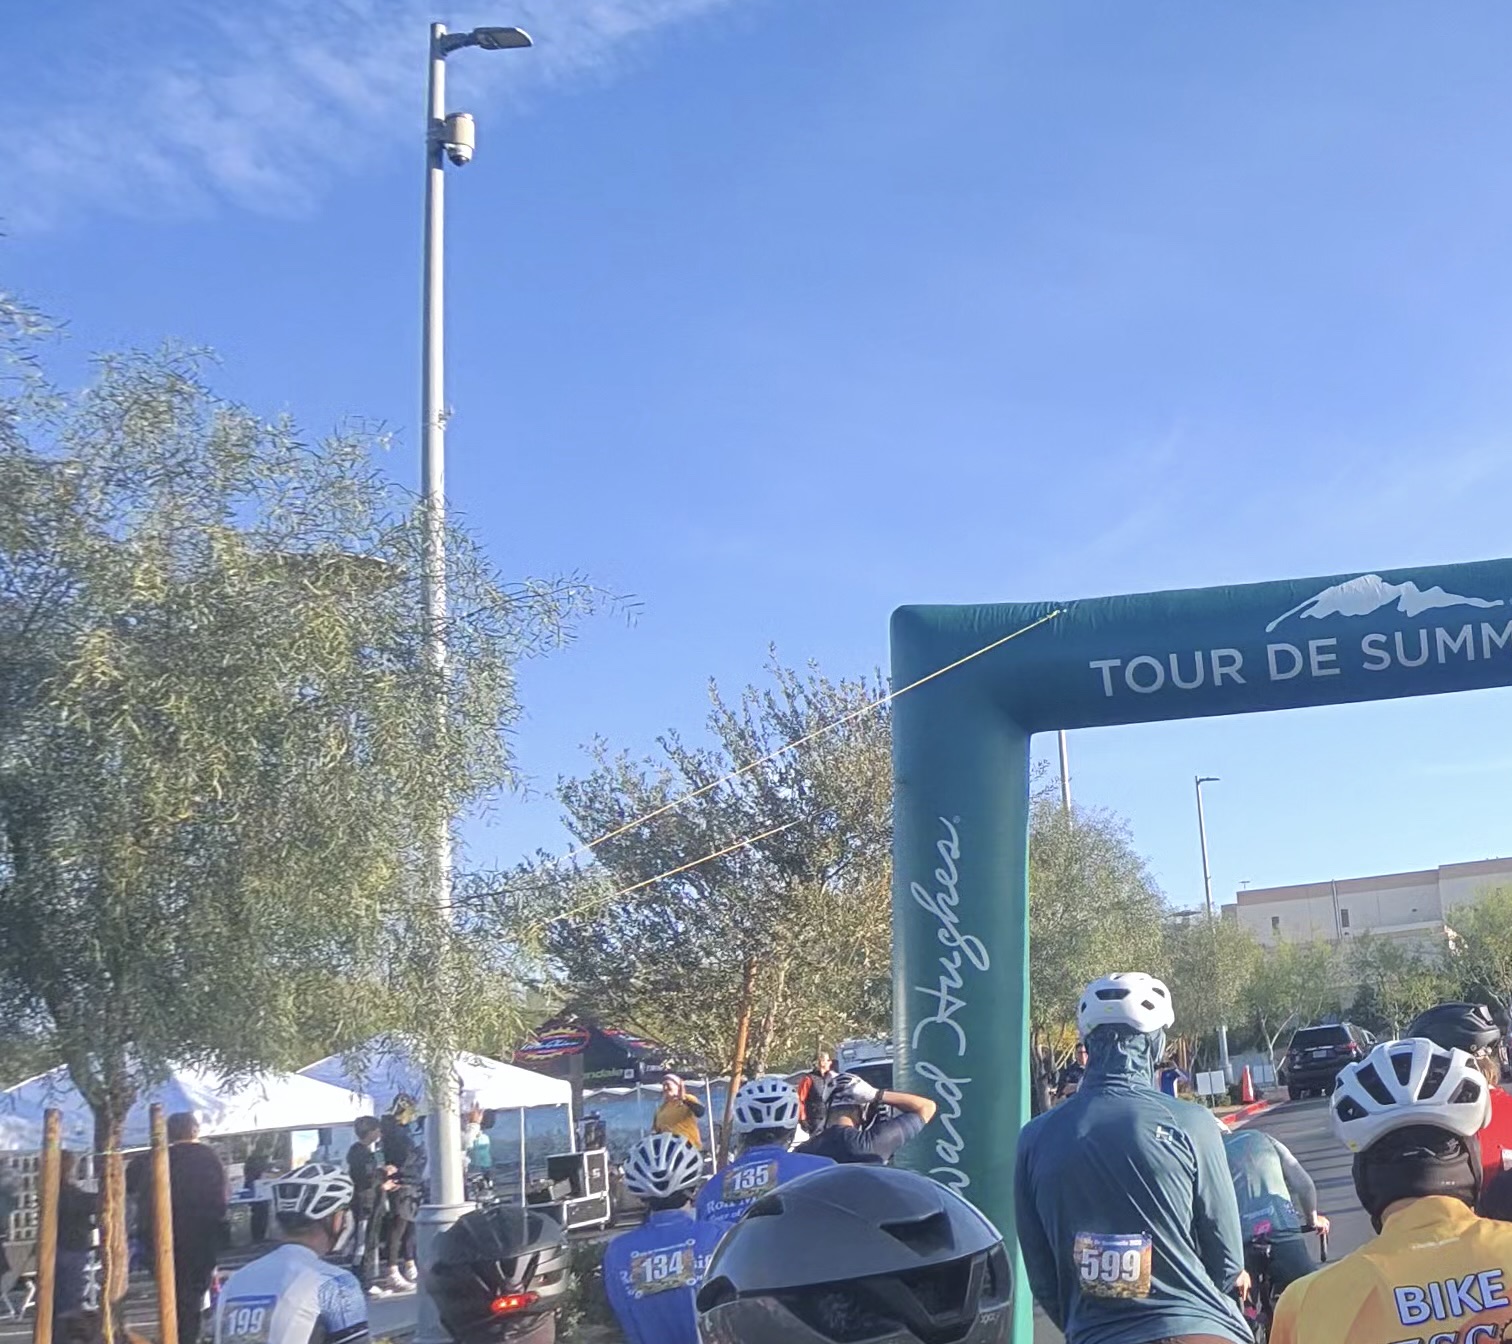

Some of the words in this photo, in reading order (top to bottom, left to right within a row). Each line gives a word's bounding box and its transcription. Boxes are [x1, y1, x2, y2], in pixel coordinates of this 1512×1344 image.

[1090, 647, 1246, 697] TOUR
[1266, 637, 1341, 682] DE
[911, 816, 989, 1056] Hughes
[732, 1164, 769, 1192] 135
[641, 1250, 684, 1284] 134
[1081, 1248, 1141, 1283] 599
[1393, 1268, 1510, 1326] BIKE
[228, 1307, 266, 1337] 199
